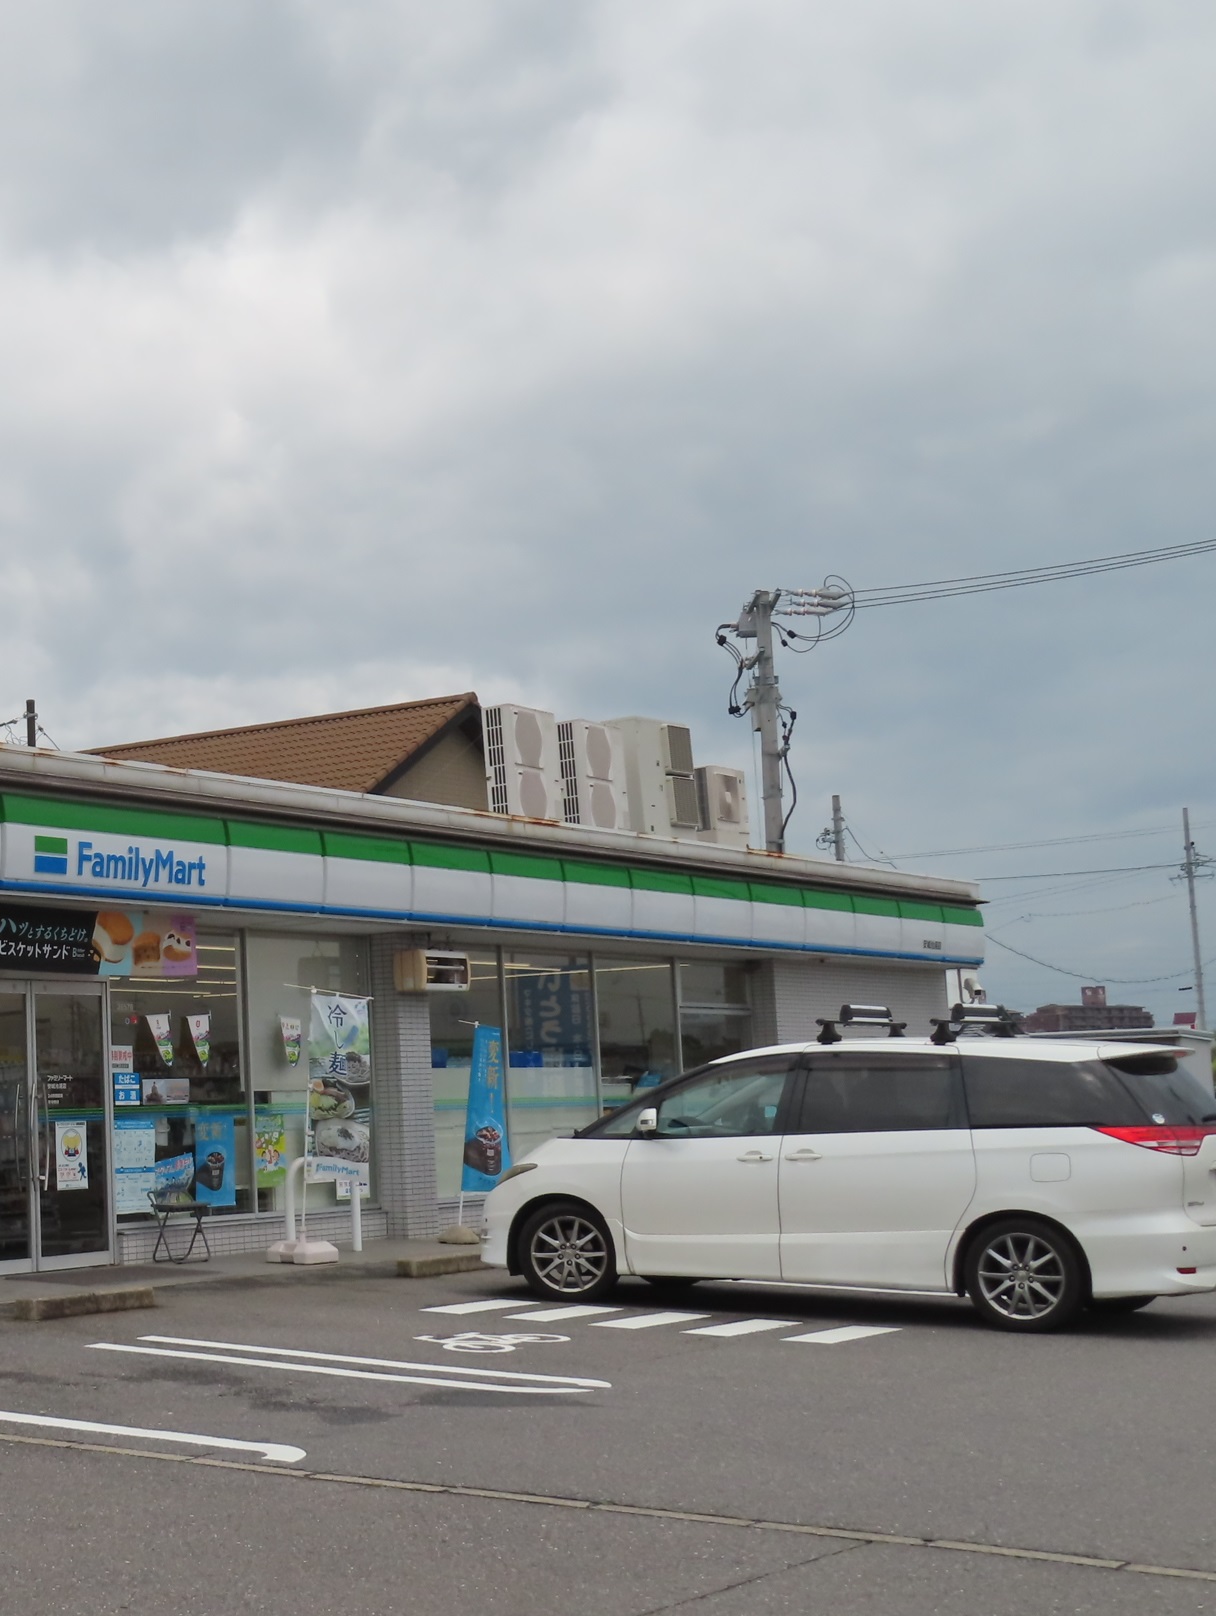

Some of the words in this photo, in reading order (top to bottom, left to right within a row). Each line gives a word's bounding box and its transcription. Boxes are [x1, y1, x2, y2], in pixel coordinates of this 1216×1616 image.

[77, 840, 206, 888] FamilyMart
[327, 1004, 348, 1076] 冷し麺
[118, 1074, 136, 1084] たばこ
